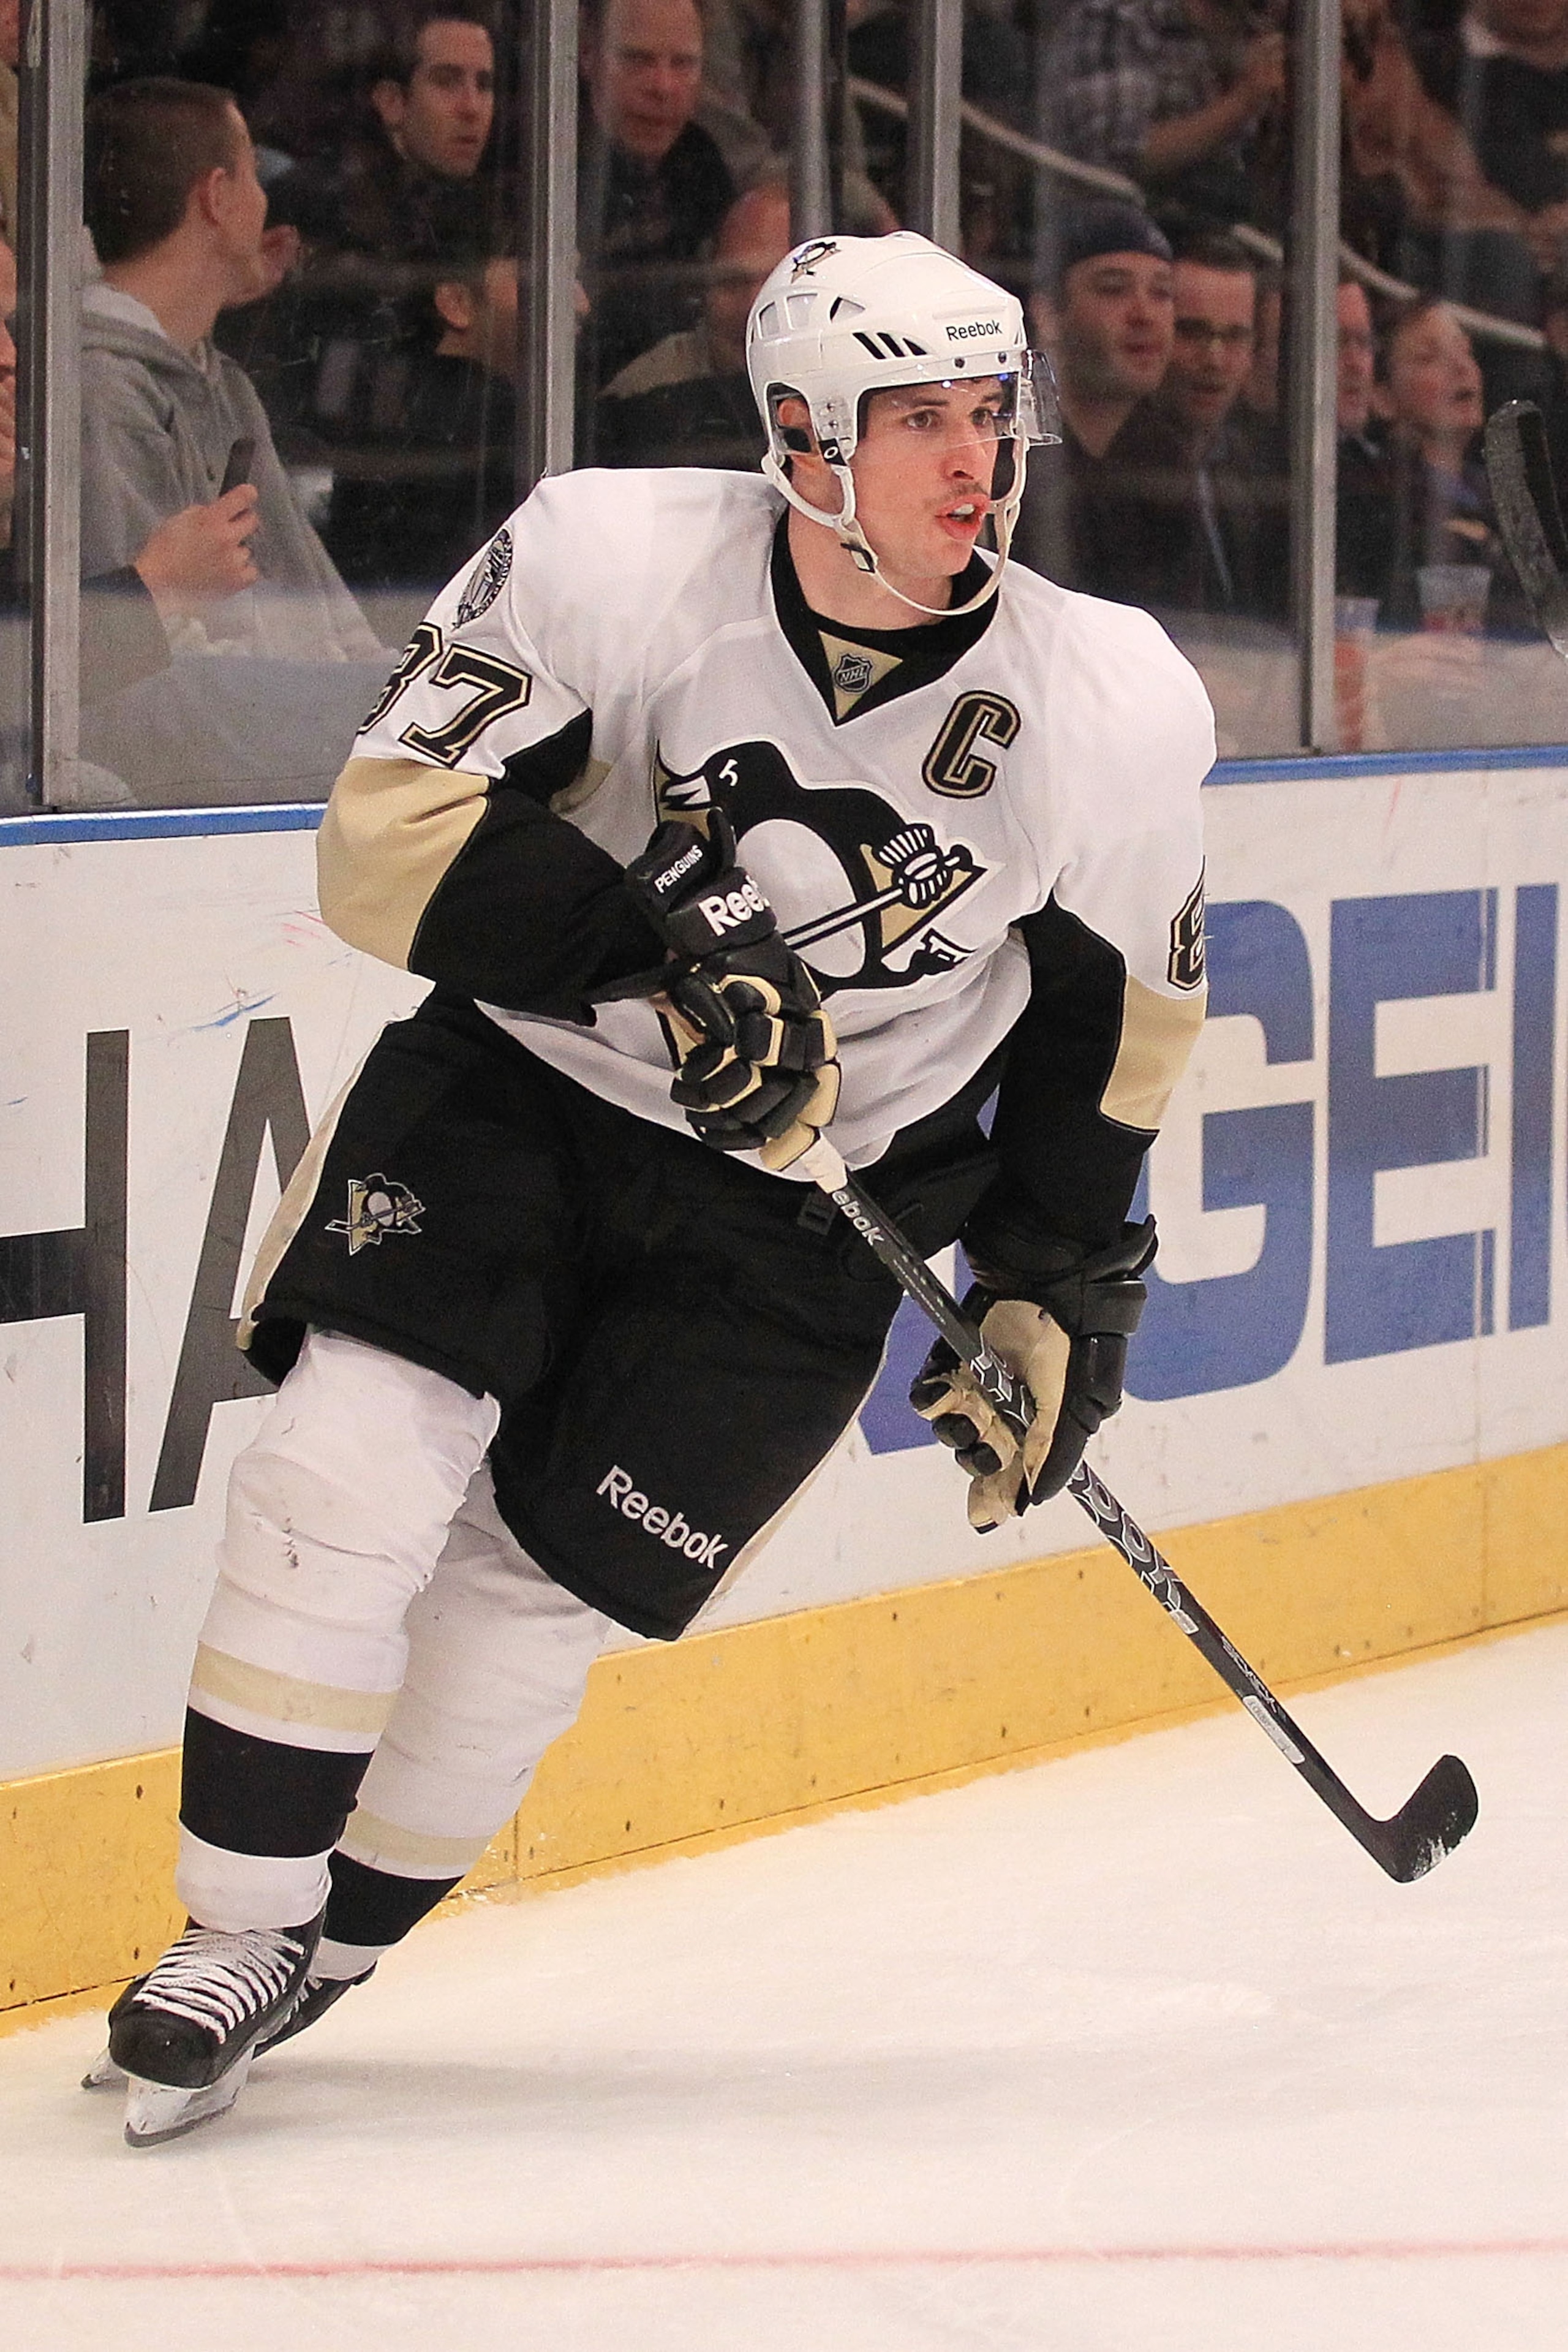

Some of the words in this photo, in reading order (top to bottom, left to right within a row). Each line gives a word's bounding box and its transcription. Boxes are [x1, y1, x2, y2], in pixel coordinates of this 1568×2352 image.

[946, 319, 1003, 341] Reebok
[840, 667, 865, 683] NHL
[922, 690, 1021, 798] C
[654, 845, 703, 893] PENGUINS
[596, 1464, 728, 1570] Reebok
